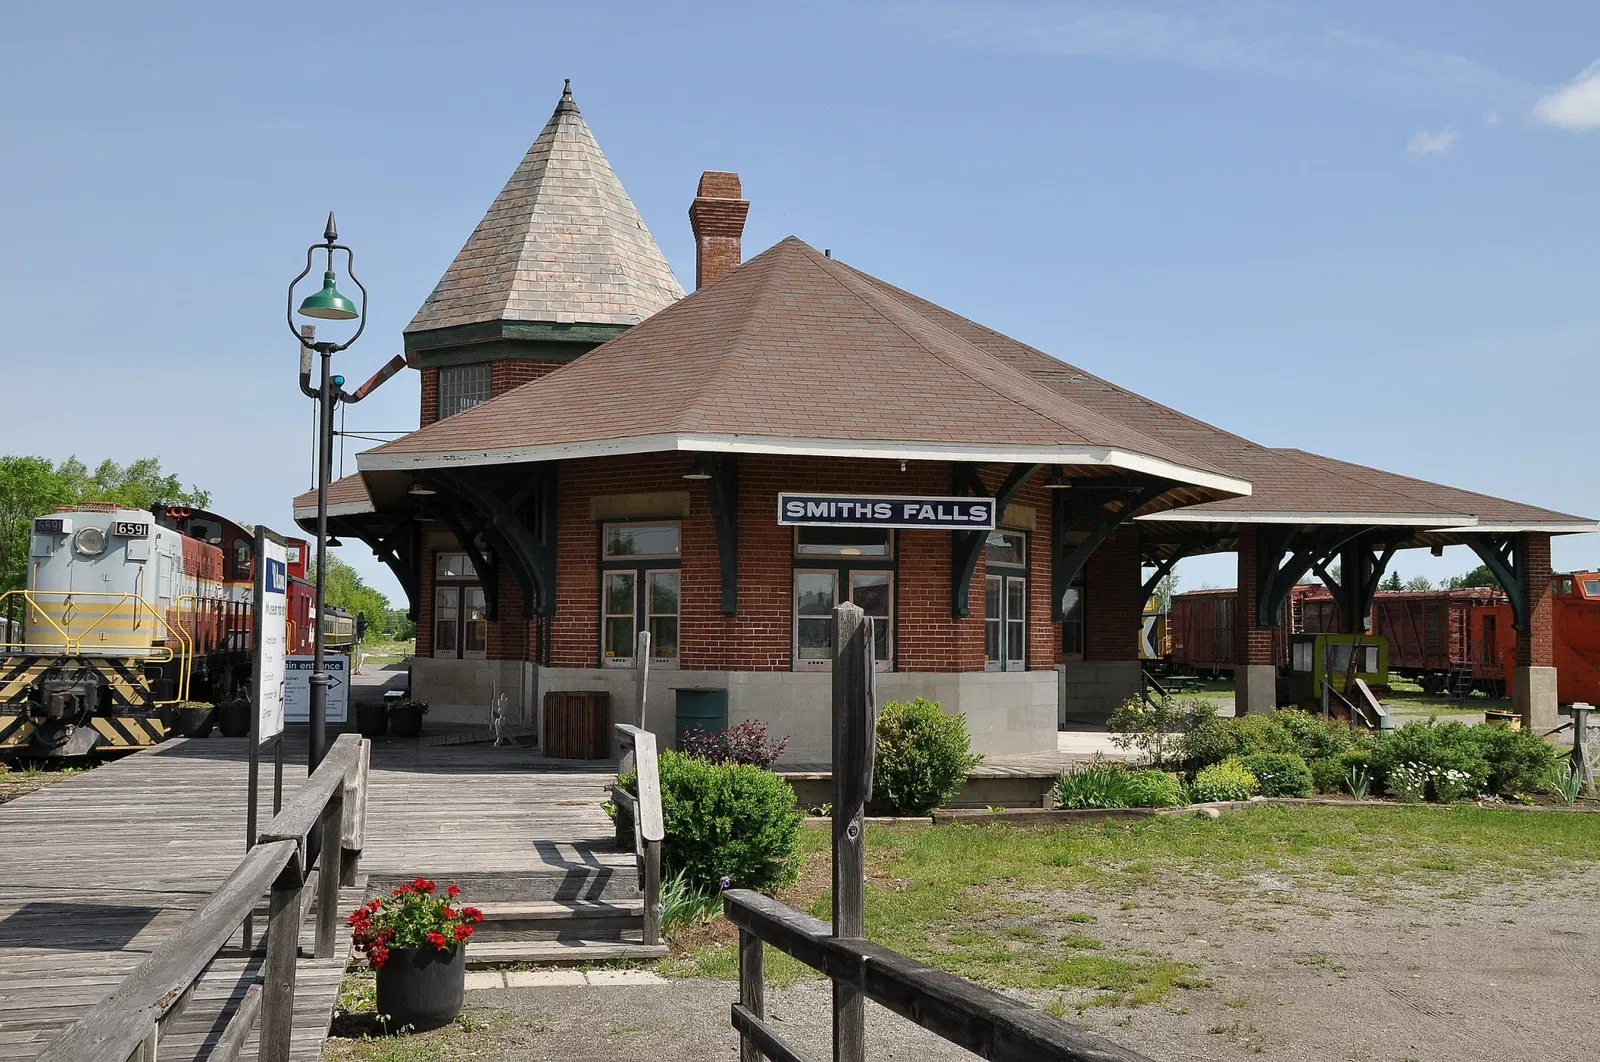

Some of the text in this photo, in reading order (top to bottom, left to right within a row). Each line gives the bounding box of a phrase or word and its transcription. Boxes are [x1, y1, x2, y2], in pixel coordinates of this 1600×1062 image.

[786, 501, 988, 522] SMITHS FALLS
[38, 520, 62, 530] 6591
[118, 523, 147, 535] 6591
[285, 661, 341, 670] ain entnce
